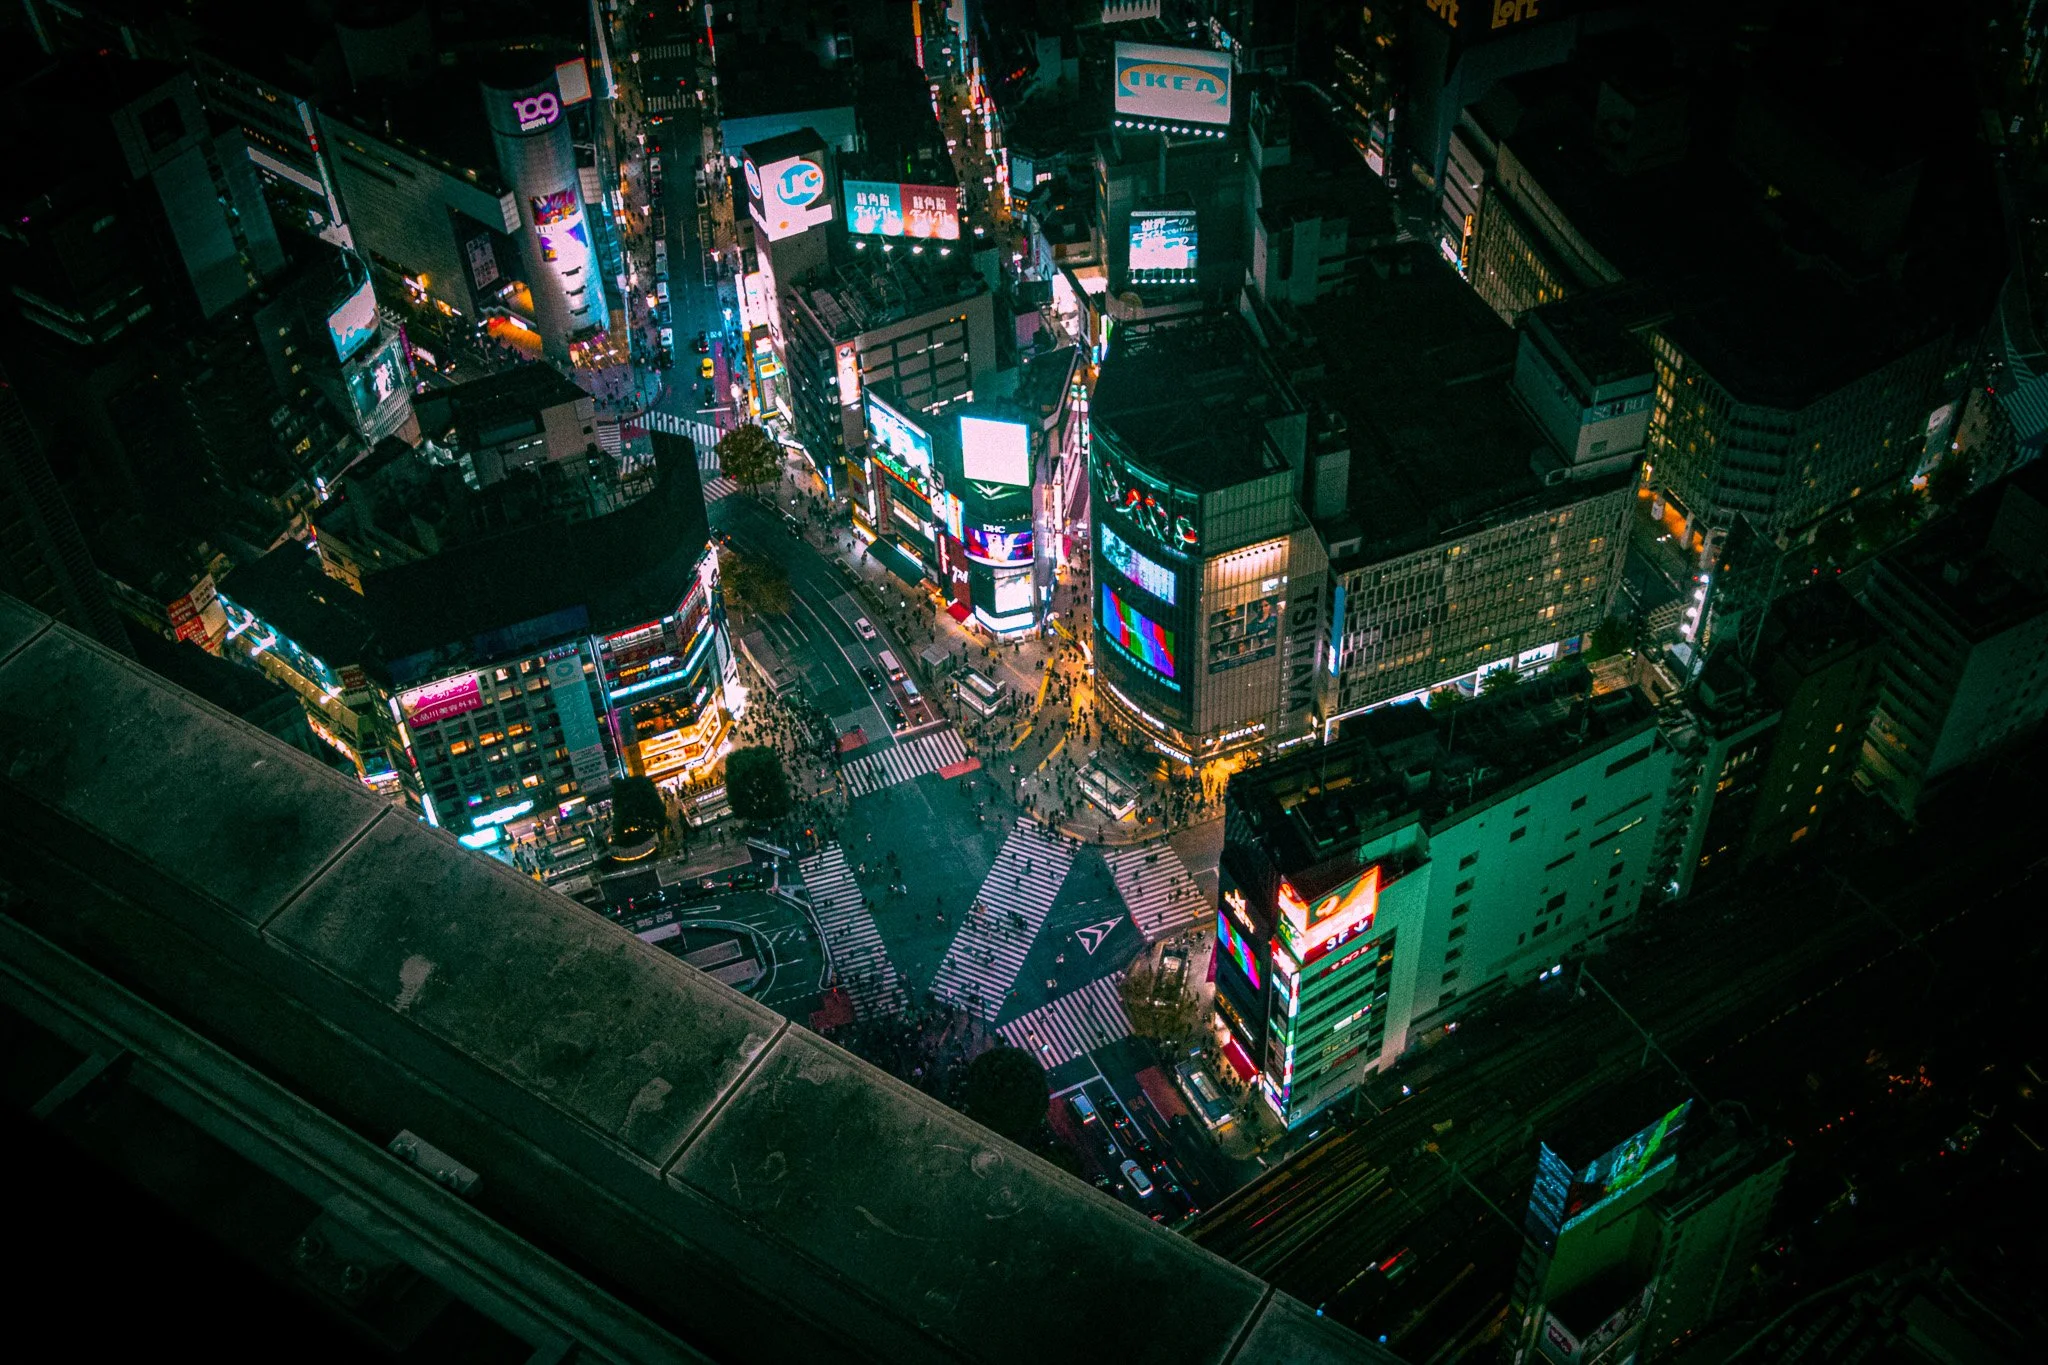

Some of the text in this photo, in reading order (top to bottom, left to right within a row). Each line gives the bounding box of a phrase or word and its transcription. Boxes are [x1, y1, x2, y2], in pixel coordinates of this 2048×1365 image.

[1129, 71, 1218, 94] IKEA
[513, 92, 559, 123] 109
[982, 523, 1005, 533] DHC
[1287, 586, 1319, 713] TSUTAYA
[1154, 740, 1192, 764] TSUTAYA
